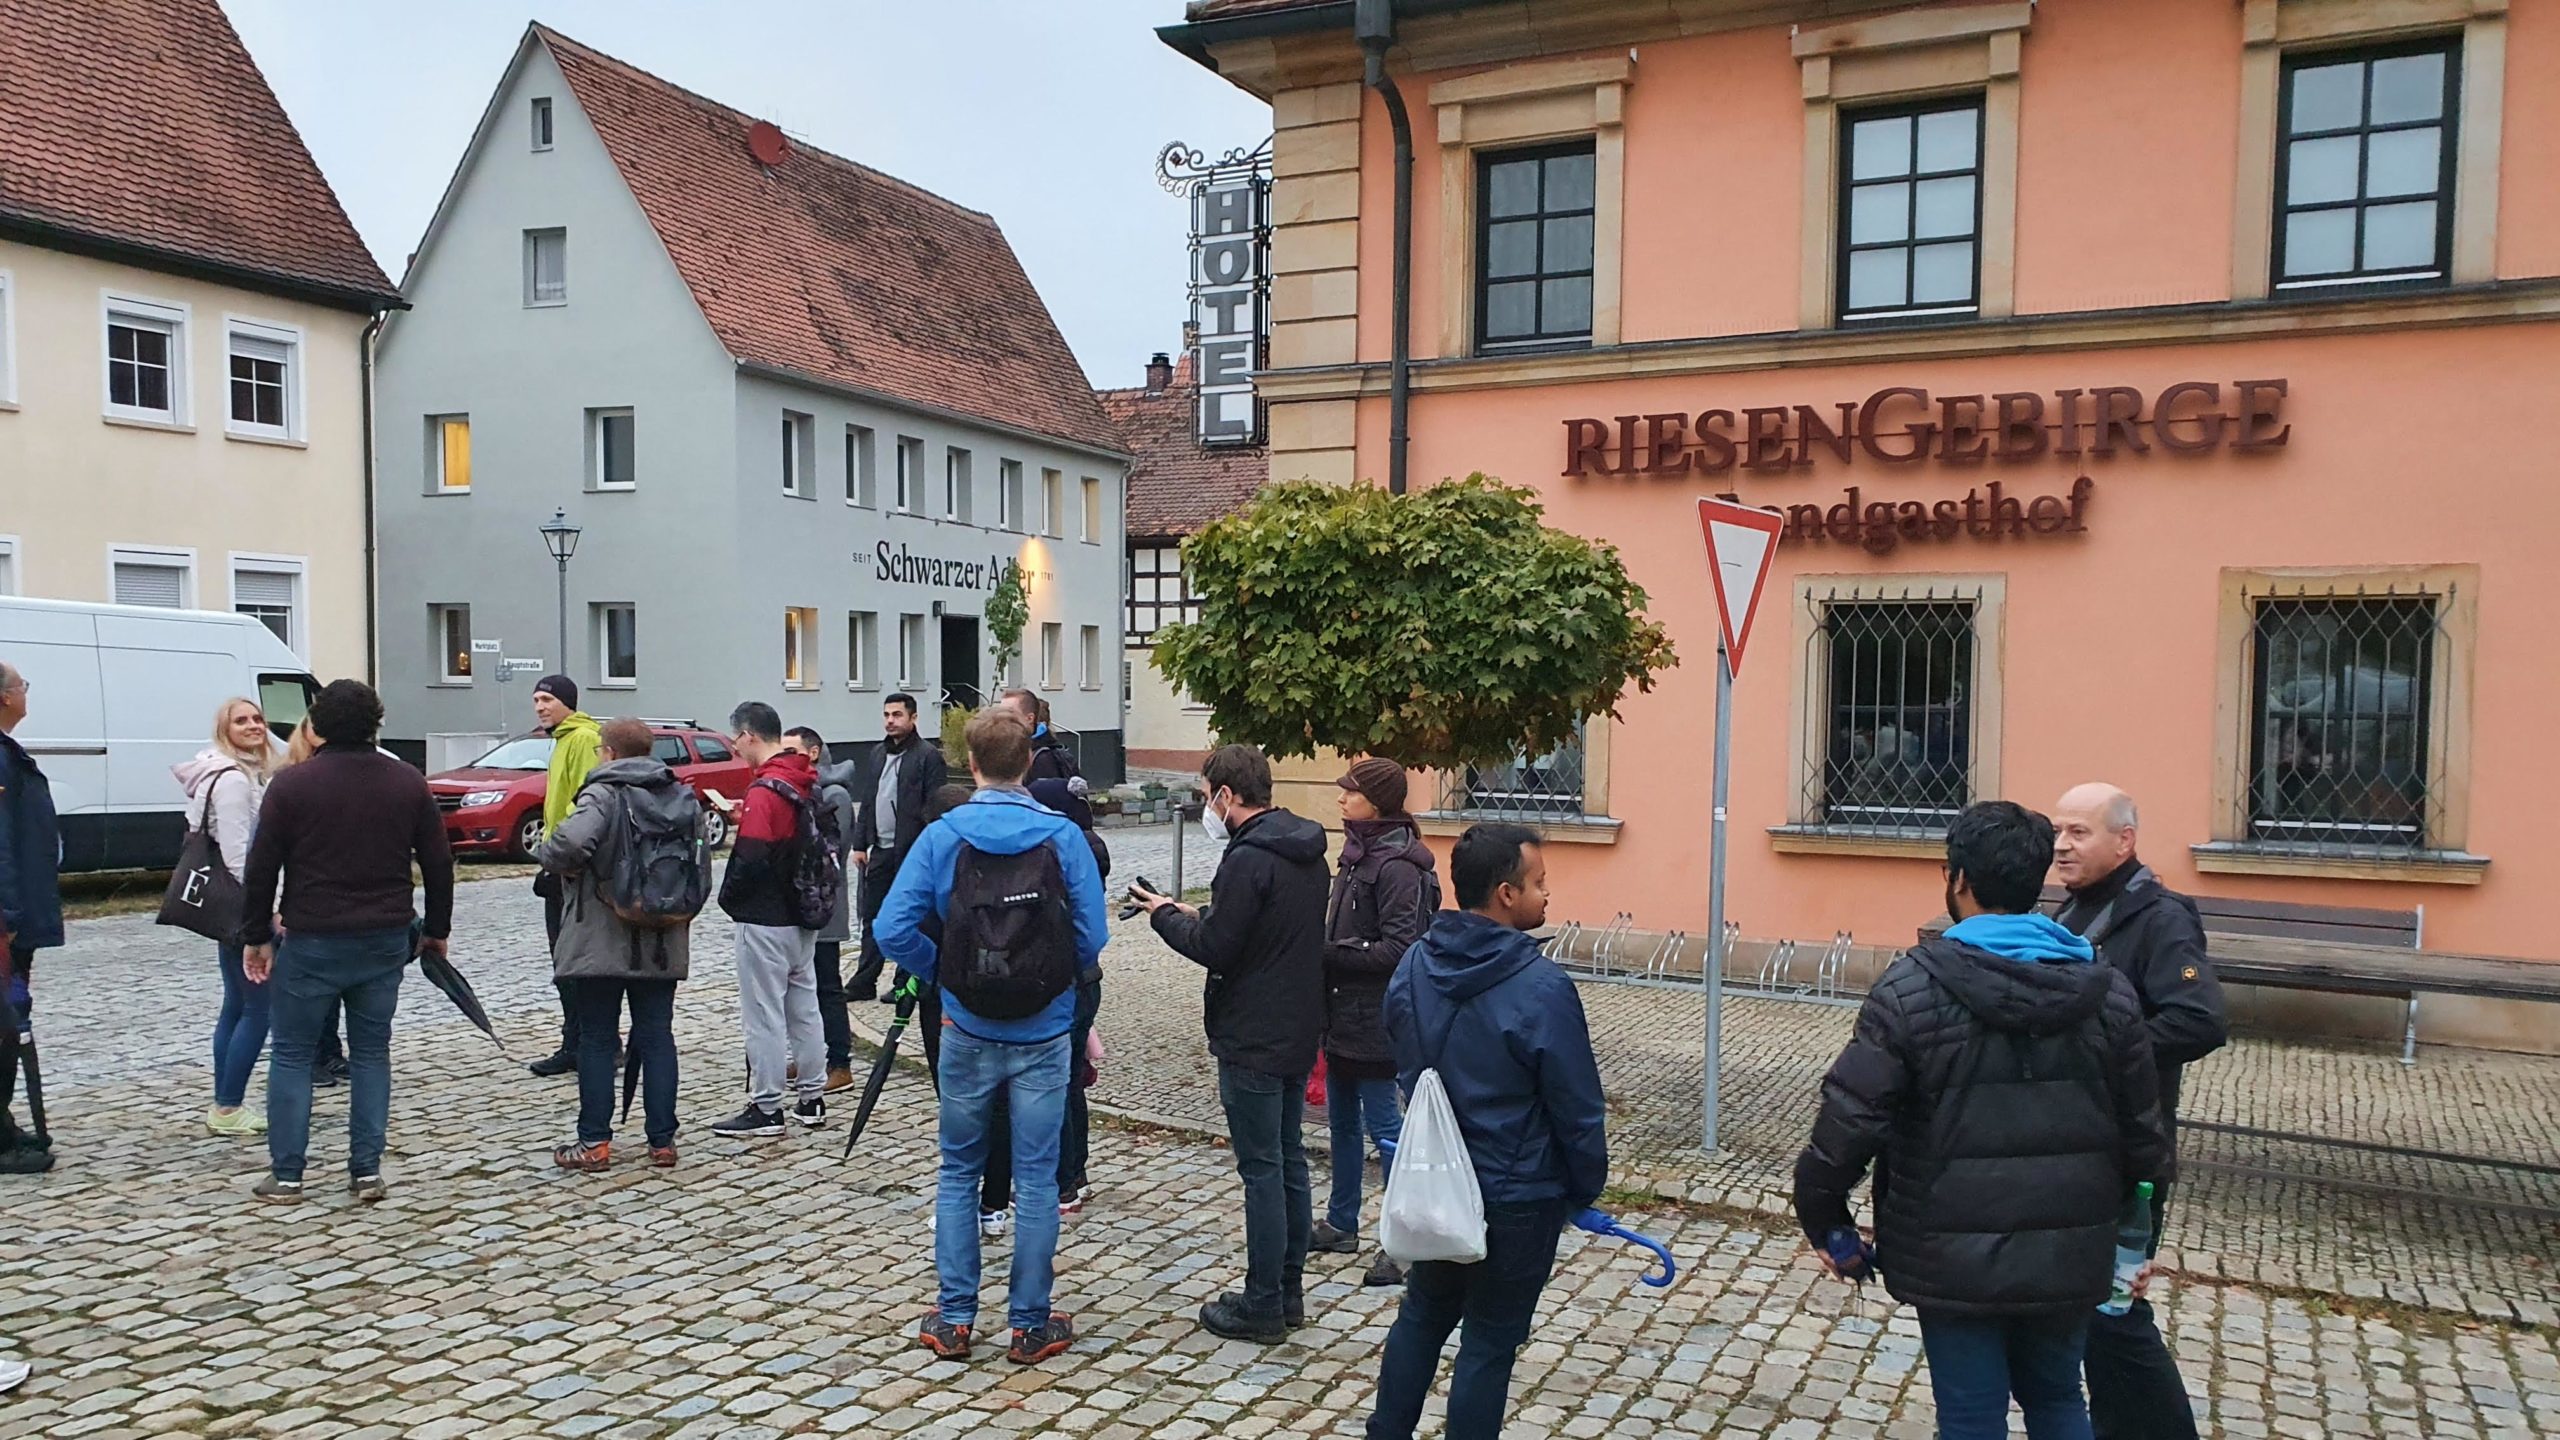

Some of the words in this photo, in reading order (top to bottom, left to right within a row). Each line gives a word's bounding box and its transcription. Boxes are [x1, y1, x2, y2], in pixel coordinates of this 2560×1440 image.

[1203, 189, 1250, 436] HOTEL
[1561, 378, 2290, 478] RIESENGEBIRGE
[1715, 477, 2093, 554] ndgasthof
[852, 552, 872, 564] SEIT
[876, 540, 984, 590] Schwarzer
[180, 865, 211, 908] É
